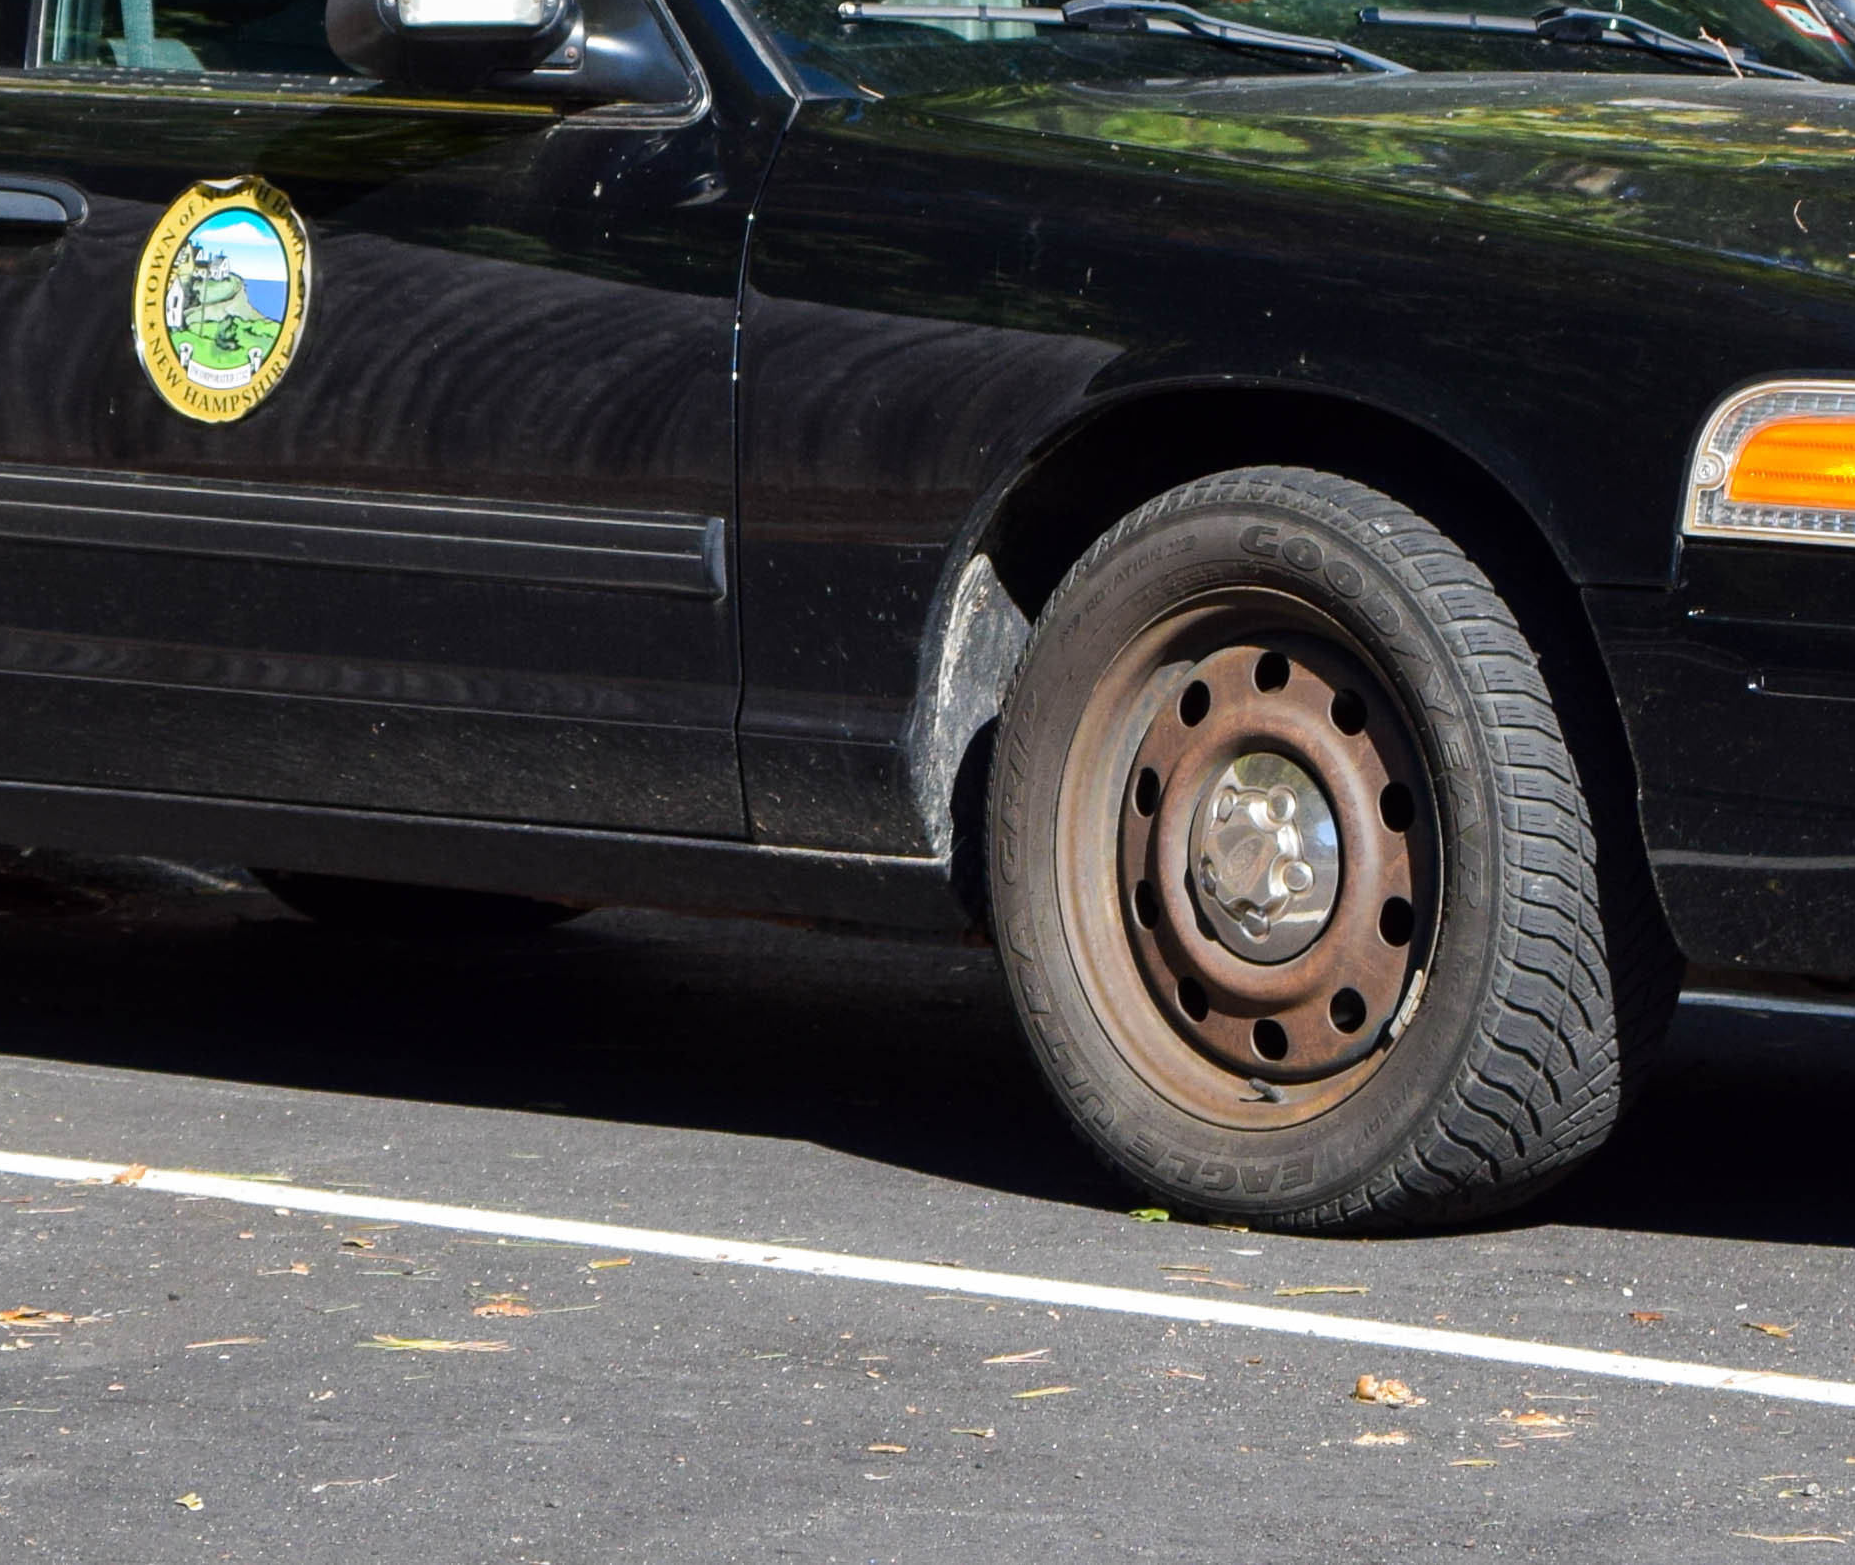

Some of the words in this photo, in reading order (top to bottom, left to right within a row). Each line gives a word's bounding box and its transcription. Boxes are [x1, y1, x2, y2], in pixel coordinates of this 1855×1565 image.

[145, 228, 176, 312] TOWN
[179, 200, 195, 226] of
[149, 336, 183, 388] NEW
[183, 344, 292, 414] HAMPSHIRE
[1239, 522, 1486, 909] GOODYEAR
[1005, 905, 1120, 1132] ULTRA
[1125, 1129, 1316, 1194] EAGLE
